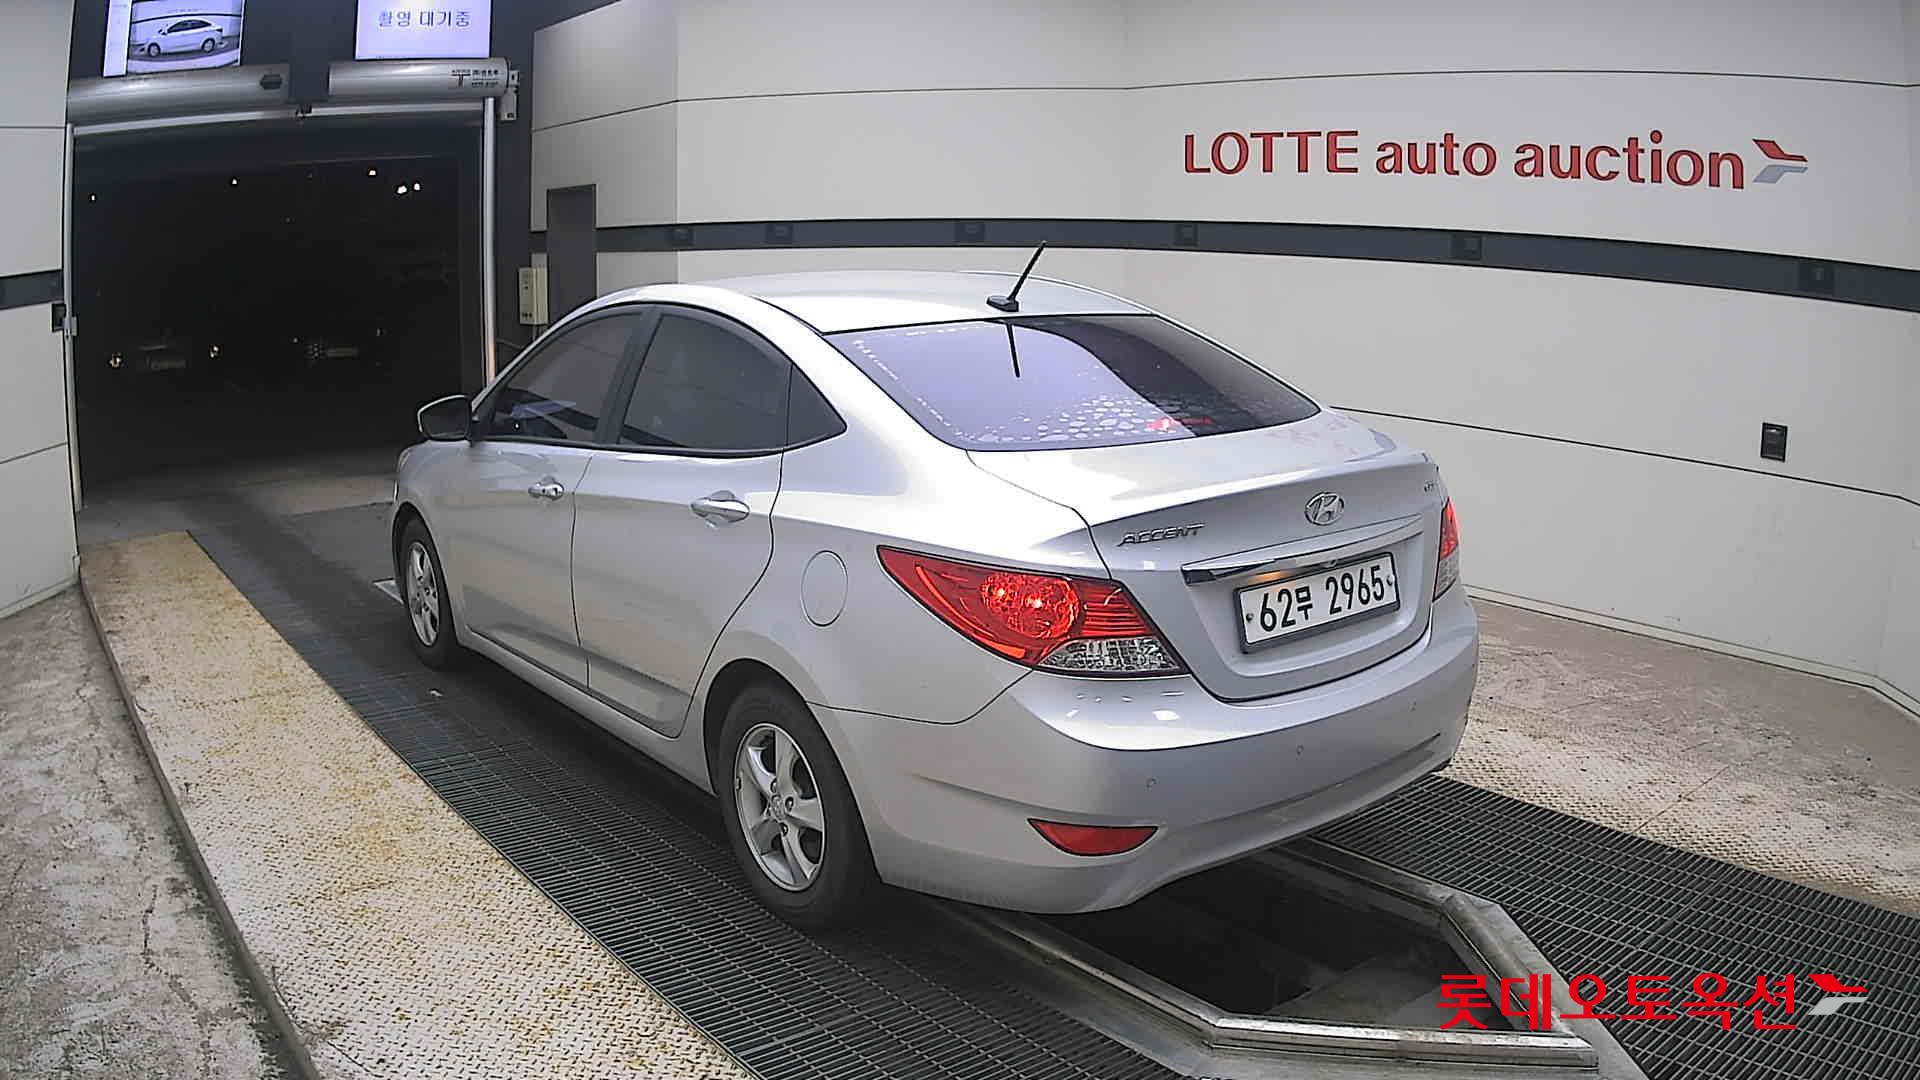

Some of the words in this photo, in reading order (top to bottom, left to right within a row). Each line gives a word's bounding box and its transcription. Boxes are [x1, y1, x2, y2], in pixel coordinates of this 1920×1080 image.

[419, 10, 471, 27] 대기중
[1184, 130, 1359, 174] LOTTE
[1376, 132, 1497, 177] auto
[1513, 130, 1744, 189] auction
[1116, 522, 1206, 547] ACCENT
[1259, 585, 1313, 632] 62무
[1325, 564, 1385, 615] 2965
